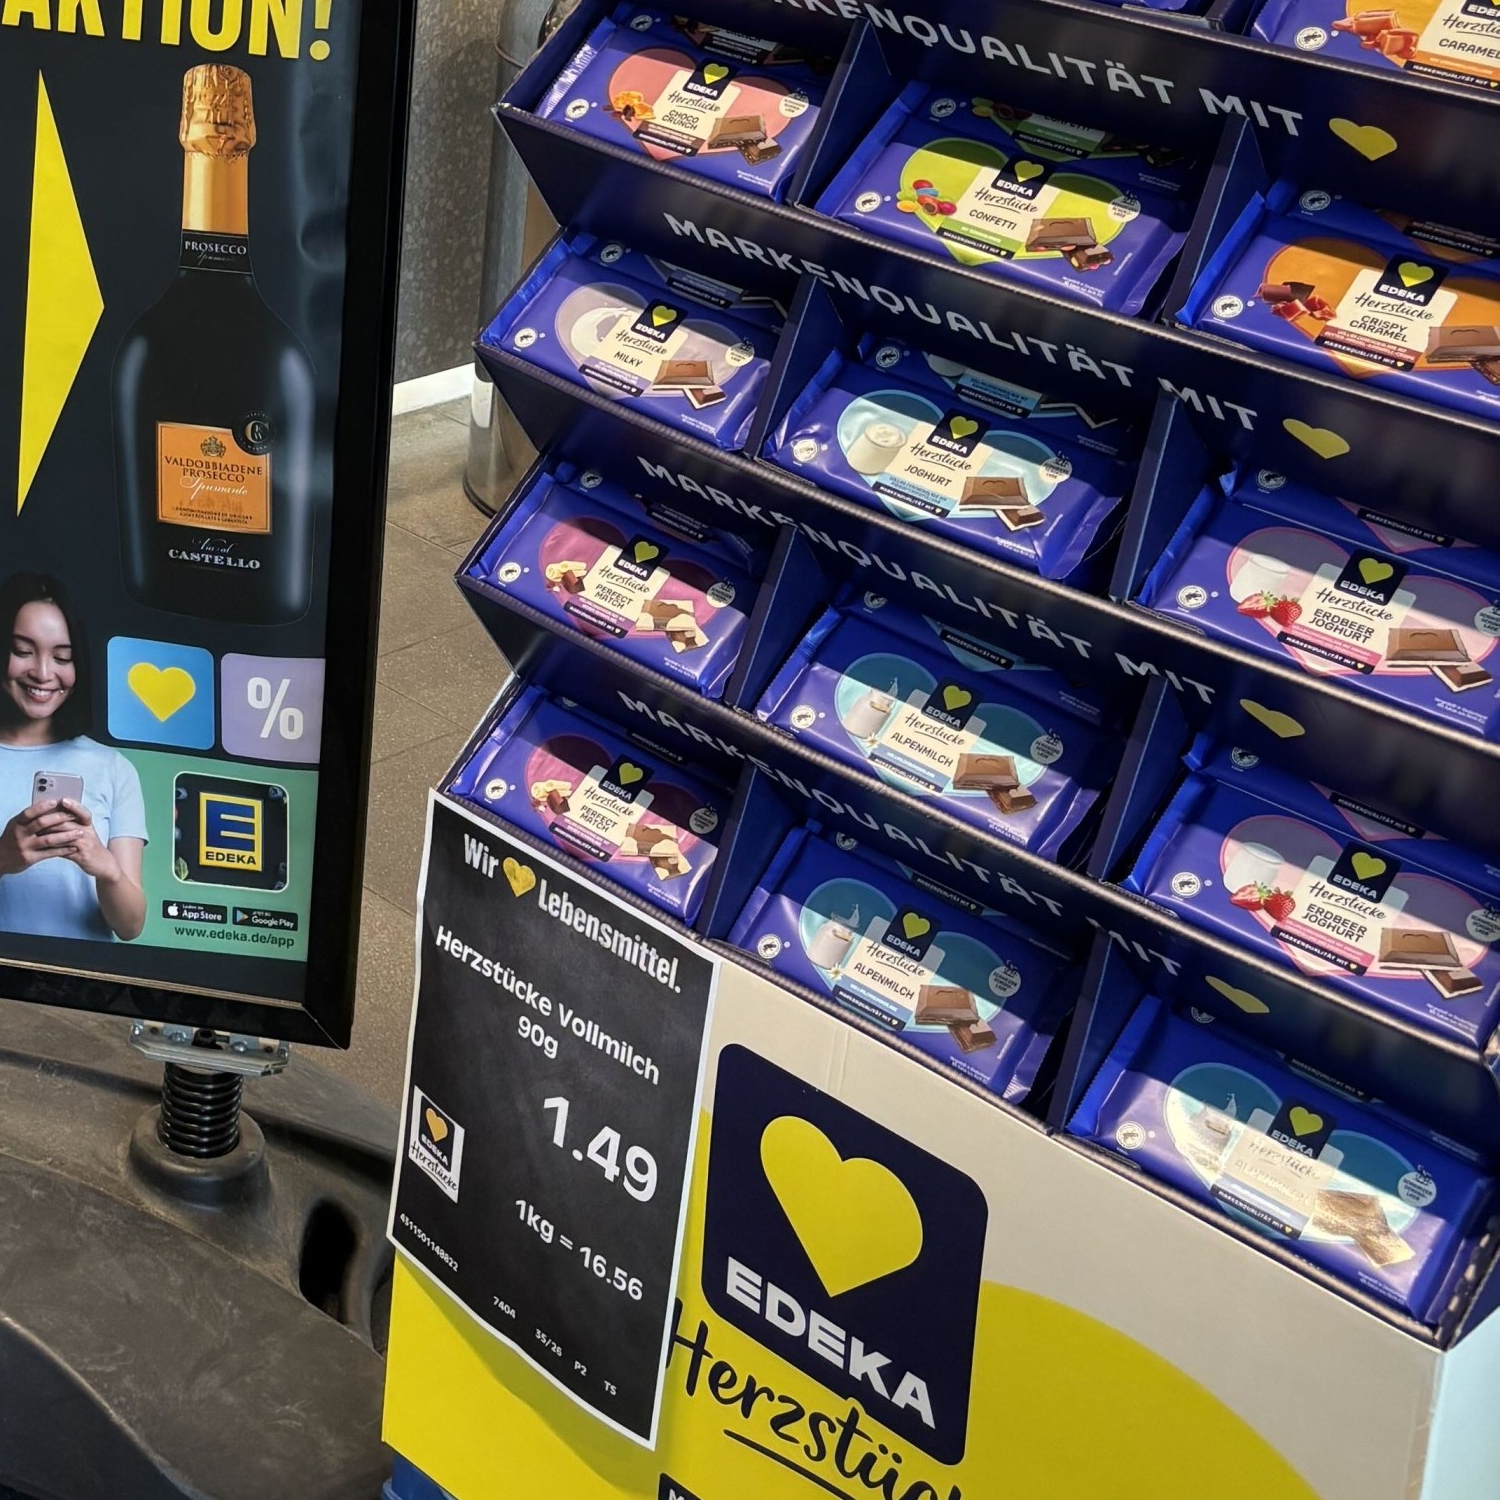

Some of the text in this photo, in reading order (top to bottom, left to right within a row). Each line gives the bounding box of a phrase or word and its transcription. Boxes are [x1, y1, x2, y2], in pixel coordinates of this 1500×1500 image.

[667, 90, 721, 113] Herzstücke
[686, 82, 719, 98] EDEKA
[661, 114, 698, 131] CRUNCH
[668, 109, 700, 124] CHOCO
[1199, 86, 1304, 137] MIT
[974, 186, 1039, 214] Herzstücke
[996, 179, 1034, 198] EDEKA
[968, 208, 1017, 231] CONFETTI
[183, 239, 248, 256] PROSECCO
[1378, 283, 1425, 303] EDEKA
[1354, 292, 1434, 320] Herzstücke
[635, 323, 666, 340] EDEKA
[663, 212, 1258, 432] MARKENQUALITÄT MIT
[1349, 319, 1408, 343] CARAMEL
[1360, 315, 1409, 333] CRISPY
[615, 329, 667, 355] Herzstücke
[613, 351, 644, 368] MILKY
[910, 442, 973, 471] Herzstücke
[931, 435, 969, 455] EDEKA
[164, 454, 264, 477] VALDOBBIADENE
[182, 467, 246, 484] PROSECCO
[904, 464, 953, 488] JOGHURT
[167, 547, 262, 571] CASTELLO
[617, 558, 649, 578] EDEKA
[598, 565, 651, 593] Herzstücke
[637, 455, 1216, 705] MARKENQUALITÄT MIT
[1339, 580, 1386, 602] EDEKA
[594, 590, 625, 610] MATCH
[595, 583, 634, 606] PERFECT
[1315, 586, 1394, 621] Herzstücke
[1308, 617, 1372, 645] JOGHURT
[1312, 608, 1375, 636] ERDBEER
[617, 689, 1064, 918] MARKENQUALITÄT
[205, 851, 257, 865] EDEKA
[182, 909, 223, 921] App Store
[251, 915, 295, 929] Google Play
[465, 834, 680, 993] Wir Lebensmittel.
[174, 926, 295, 949] www.edeka.de/app
[886, 934, 922, 958] EDEKA
[865, 941, 926, 977] Herzstücke
[853, 962, 915, 1000] ALPENMILCH
[436, 926, 659, 1084] Herzstücke Vollmilch
[518, 1016, 558, 1058] 90g
[421, 1133, 449, 1166] EDEKA
[544, 1097, 657, 1201] 1.49
[410, 1140, 458, 1191] Herzstücke
[515, 1199, 555, 1244] 1kg
[579, 1246, 643, 1301] 16.56
[493, 1295, 516, 1319] 7404
[725, 1255, 937, 1431] EDEKA
[574, 1360, 588, 1376] P2
[603, 1380, 618, 1396] TS
[665, 1297, 963, 1500] Herzstüc
